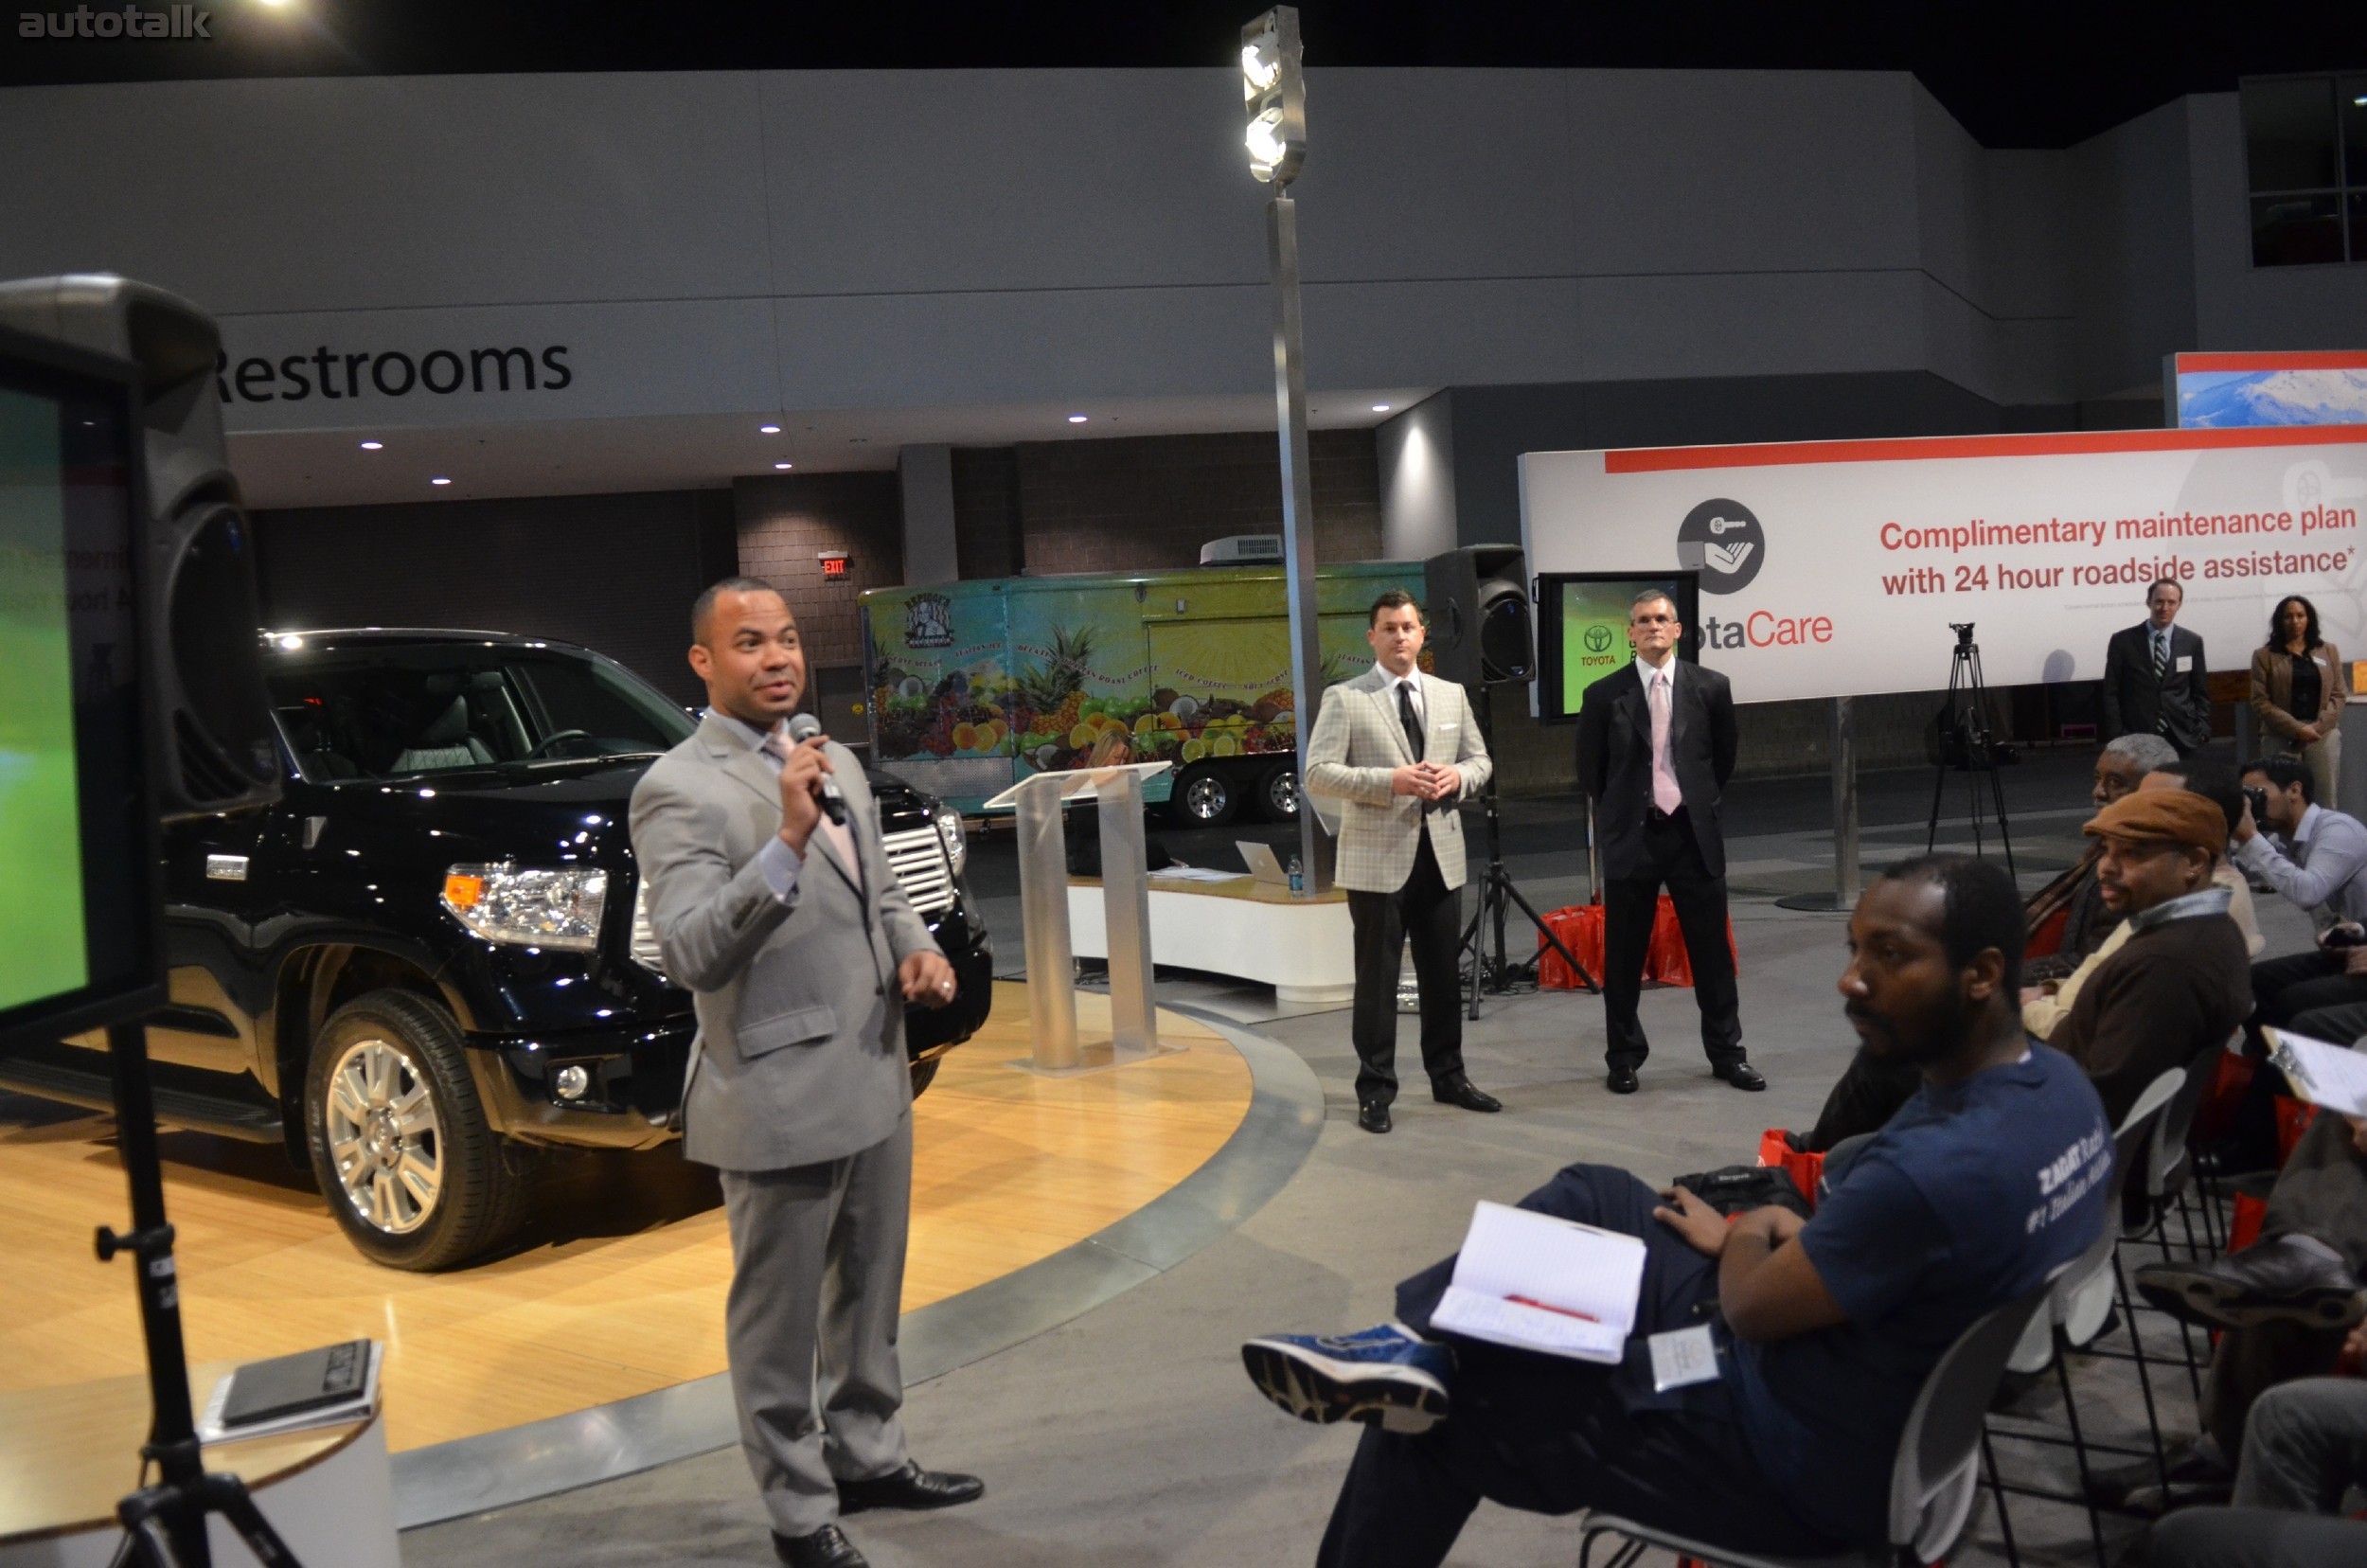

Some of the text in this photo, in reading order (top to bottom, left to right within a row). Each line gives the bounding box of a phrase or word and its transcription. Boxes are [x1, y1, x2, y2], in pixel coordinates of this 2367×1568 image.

[1880, 504, 2357, 554] Complimentary maintenance plan
[824, 560, 845, 574] EXIT
[1882, 566, 1946, 596] with
[1954, 564, 1989, 592] 24
[1998, 563, 2064, 590] hour
[2073, 555, 2195, 586] roadside
[1698, 610, 1833, 650] taCare
[1581, 655, 1616, 667] TOYOTA
[2038, 1143, 2081, 1195] ZAGAT
